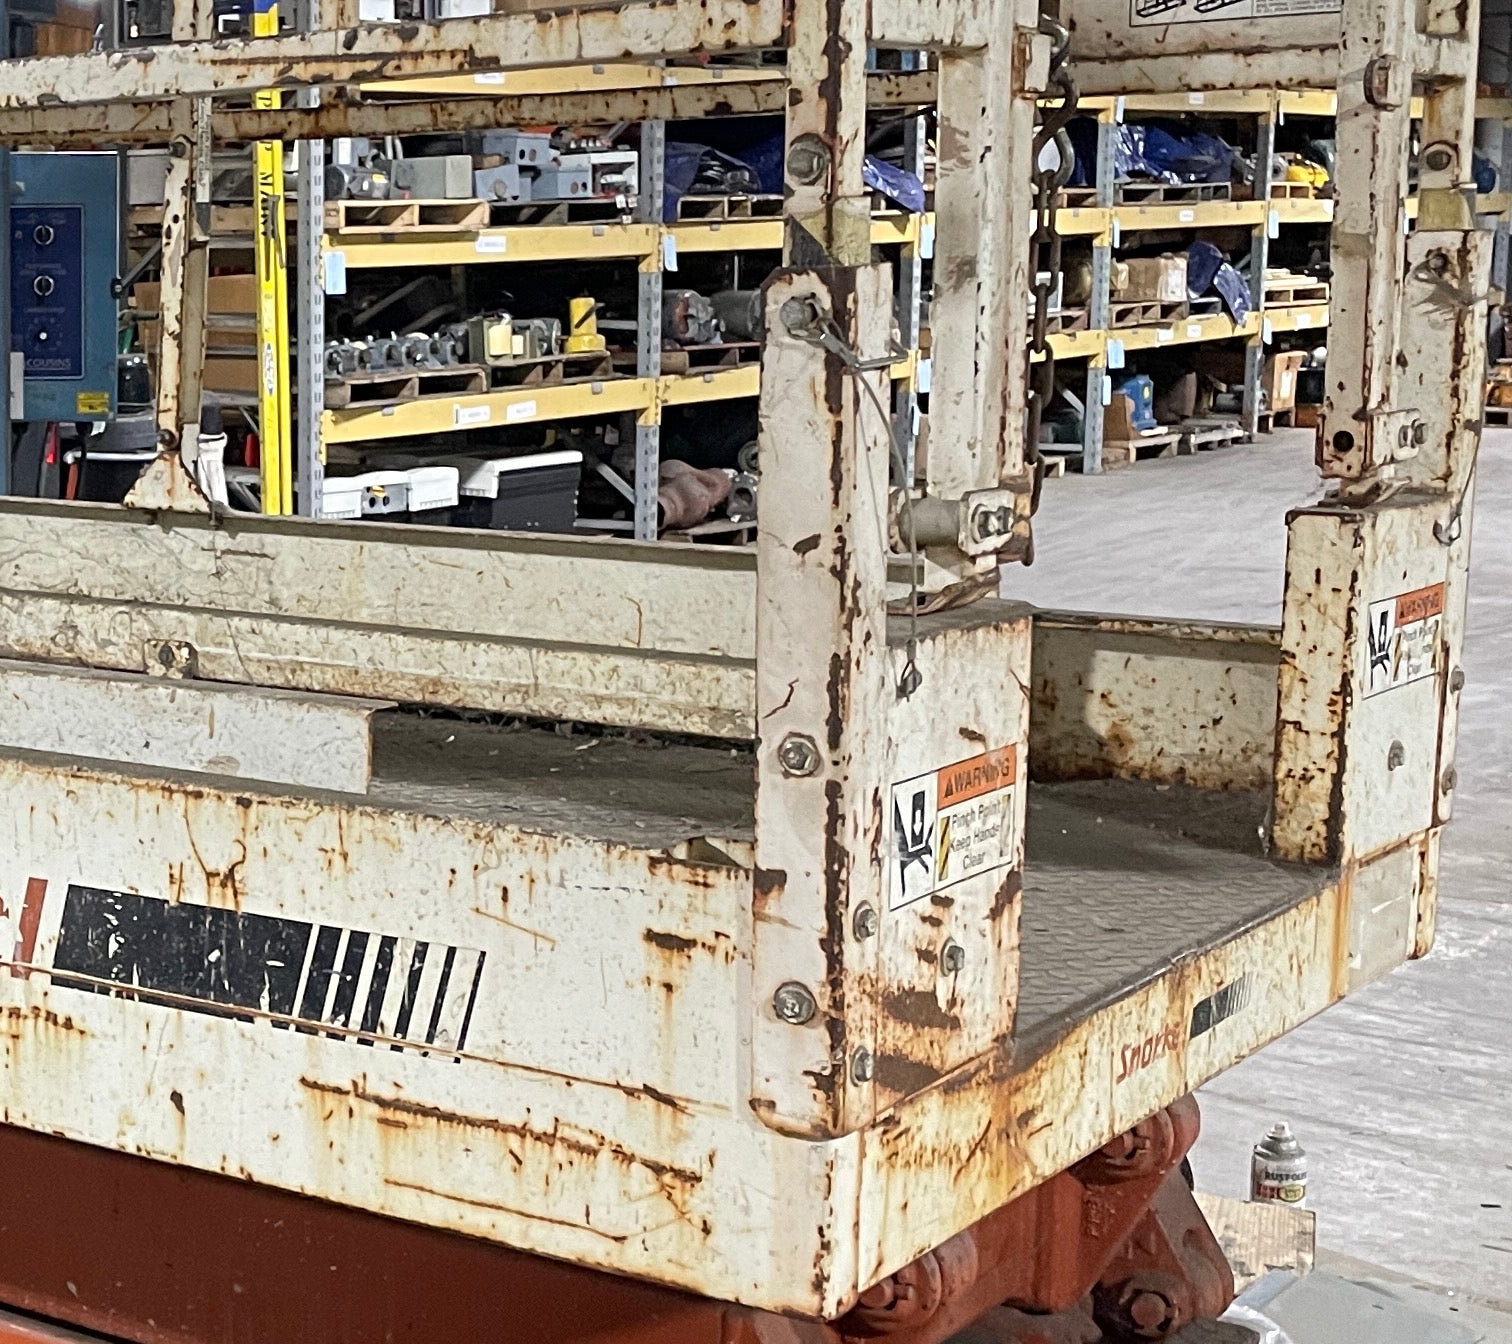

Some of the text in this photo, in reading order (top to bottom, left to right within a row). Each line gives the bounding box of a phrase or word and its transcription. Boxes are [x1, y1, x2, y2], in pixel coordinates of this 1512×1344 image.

[26, 358, 71, 368] COUSINS
[953, 757, 1011, 793] WARNING
[951, 798, 1002, 830] Pinch Point
[950, 823, 1001, 854] Keep Hands
[962, 851, 987, 870] Clear
